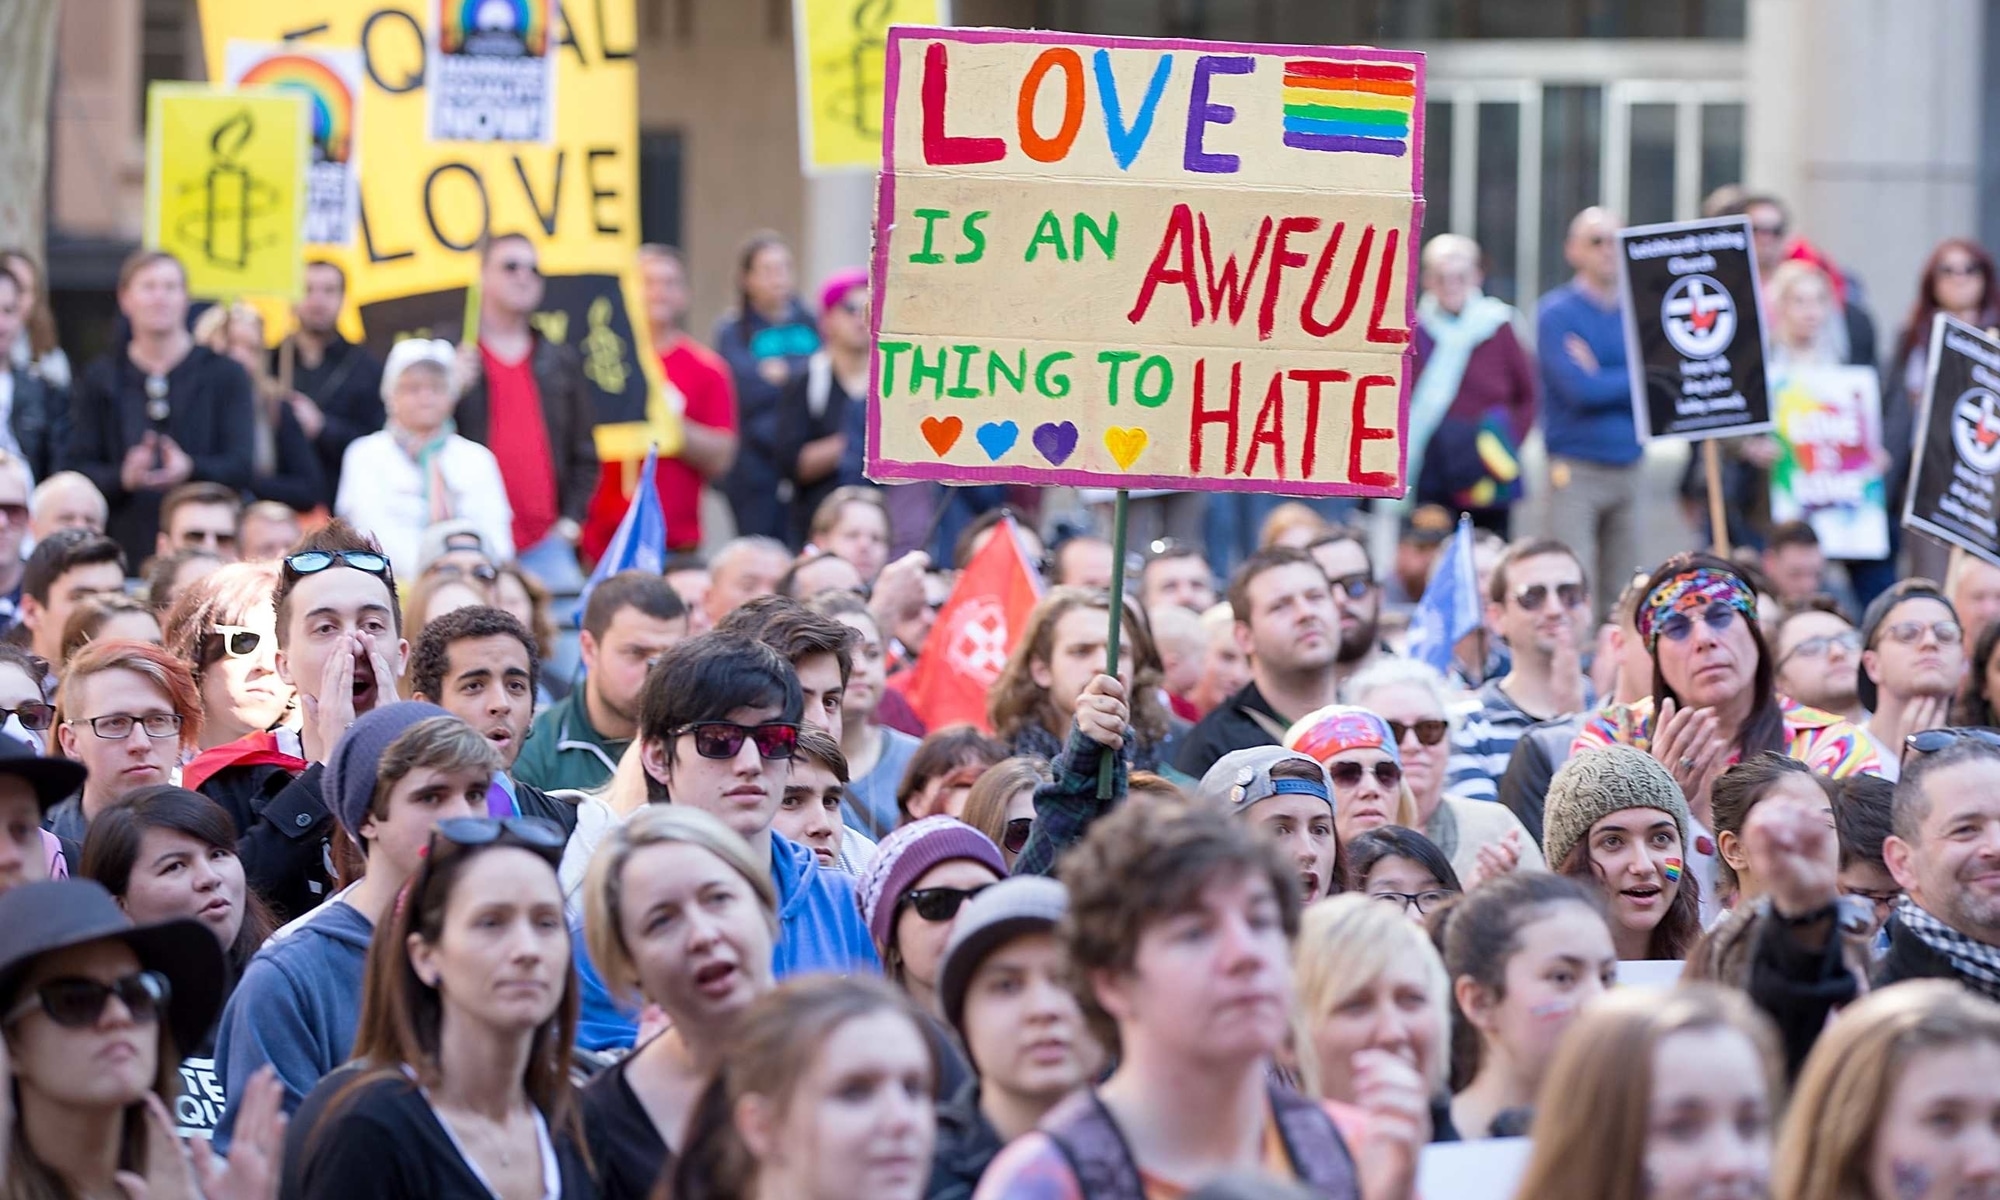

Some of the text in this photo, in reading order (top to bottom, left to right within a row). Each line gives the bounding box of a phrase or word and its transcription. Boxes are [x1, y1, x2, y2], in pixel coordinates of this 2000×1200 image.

[922, 42, 1256, 174] LOVE
[359, 150, 621, 262] LOVE
[908, 203, 1411, 344] IS AN AWFUL
[879, 341, 1398, 486] THING TO HATE
